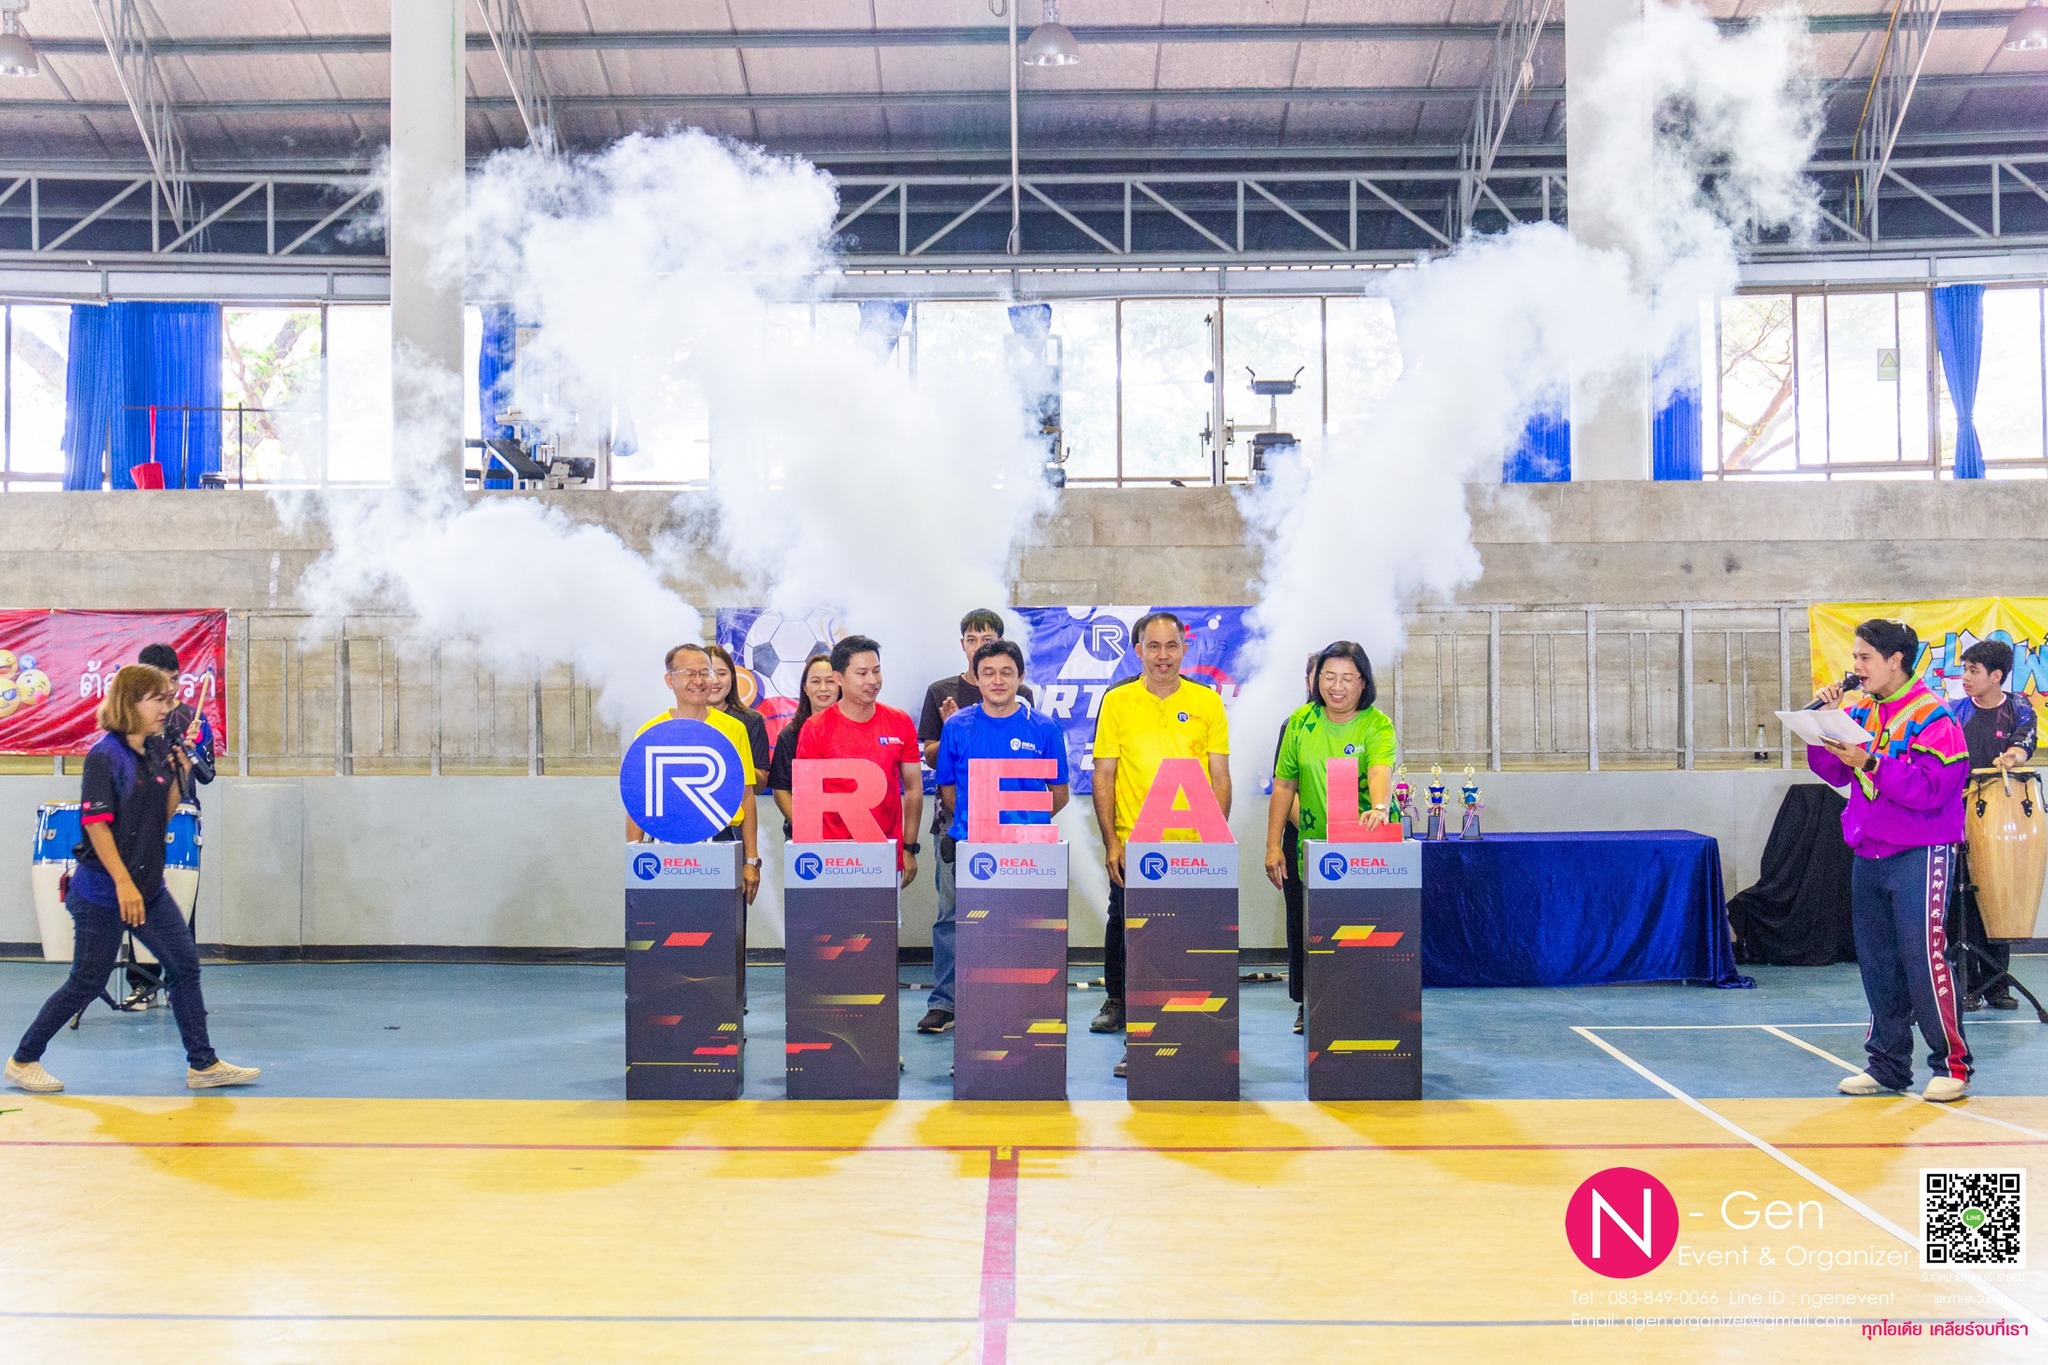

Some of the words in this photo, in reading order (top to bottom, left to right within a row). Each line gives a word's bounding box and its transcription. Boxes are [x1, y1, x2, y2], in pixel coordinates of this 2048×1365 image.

[664, 858, 701, 867] REAL
[825, 858, 862, 867] REAL
[1000, 858, 1038, 867] REAL
[1170, 858, 1208, 867] REAL
[1350, 858, 1388, 867] REAL
[664, 867, 720, 876] SOLUPLUS
[825, 867, 882, 876] SOLUPLUS
[1000, 867, 1057, 876] SOLUPLUS
[1170, 867, 1228, 876] SOLUPLUS
[1350, 867, 1407, 876] SOLUPLUS
[1932, 925, 1949, 997] RUMORS
